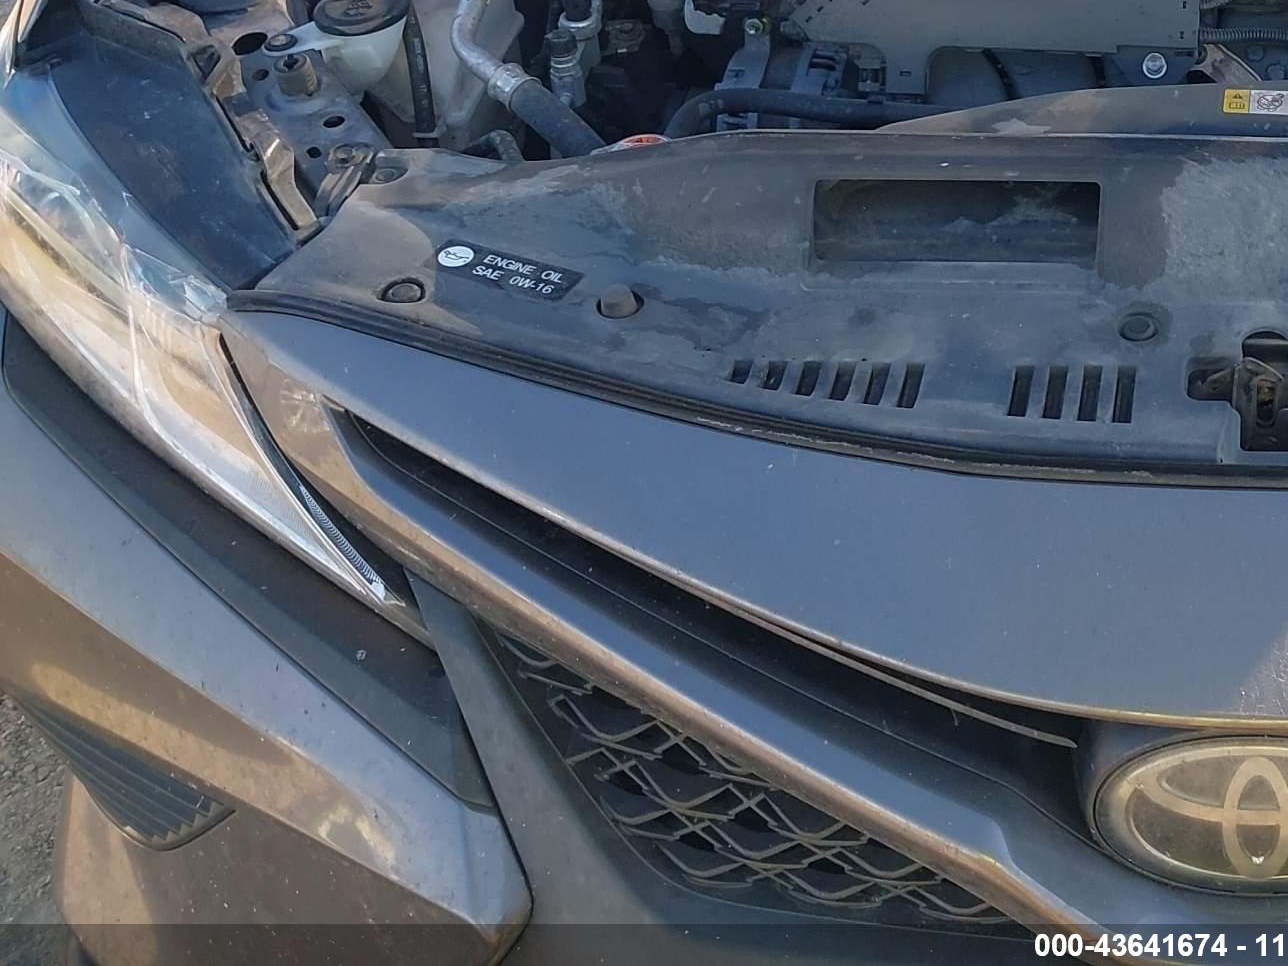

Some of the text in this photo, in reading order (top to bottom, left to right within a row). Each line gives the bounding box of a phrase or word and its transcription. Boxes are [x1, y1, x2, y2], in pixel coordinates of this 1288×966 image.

[472, 265, 555, 294] SAE 0W-16
[483, 254, 564, 284] ENGINE OIL
